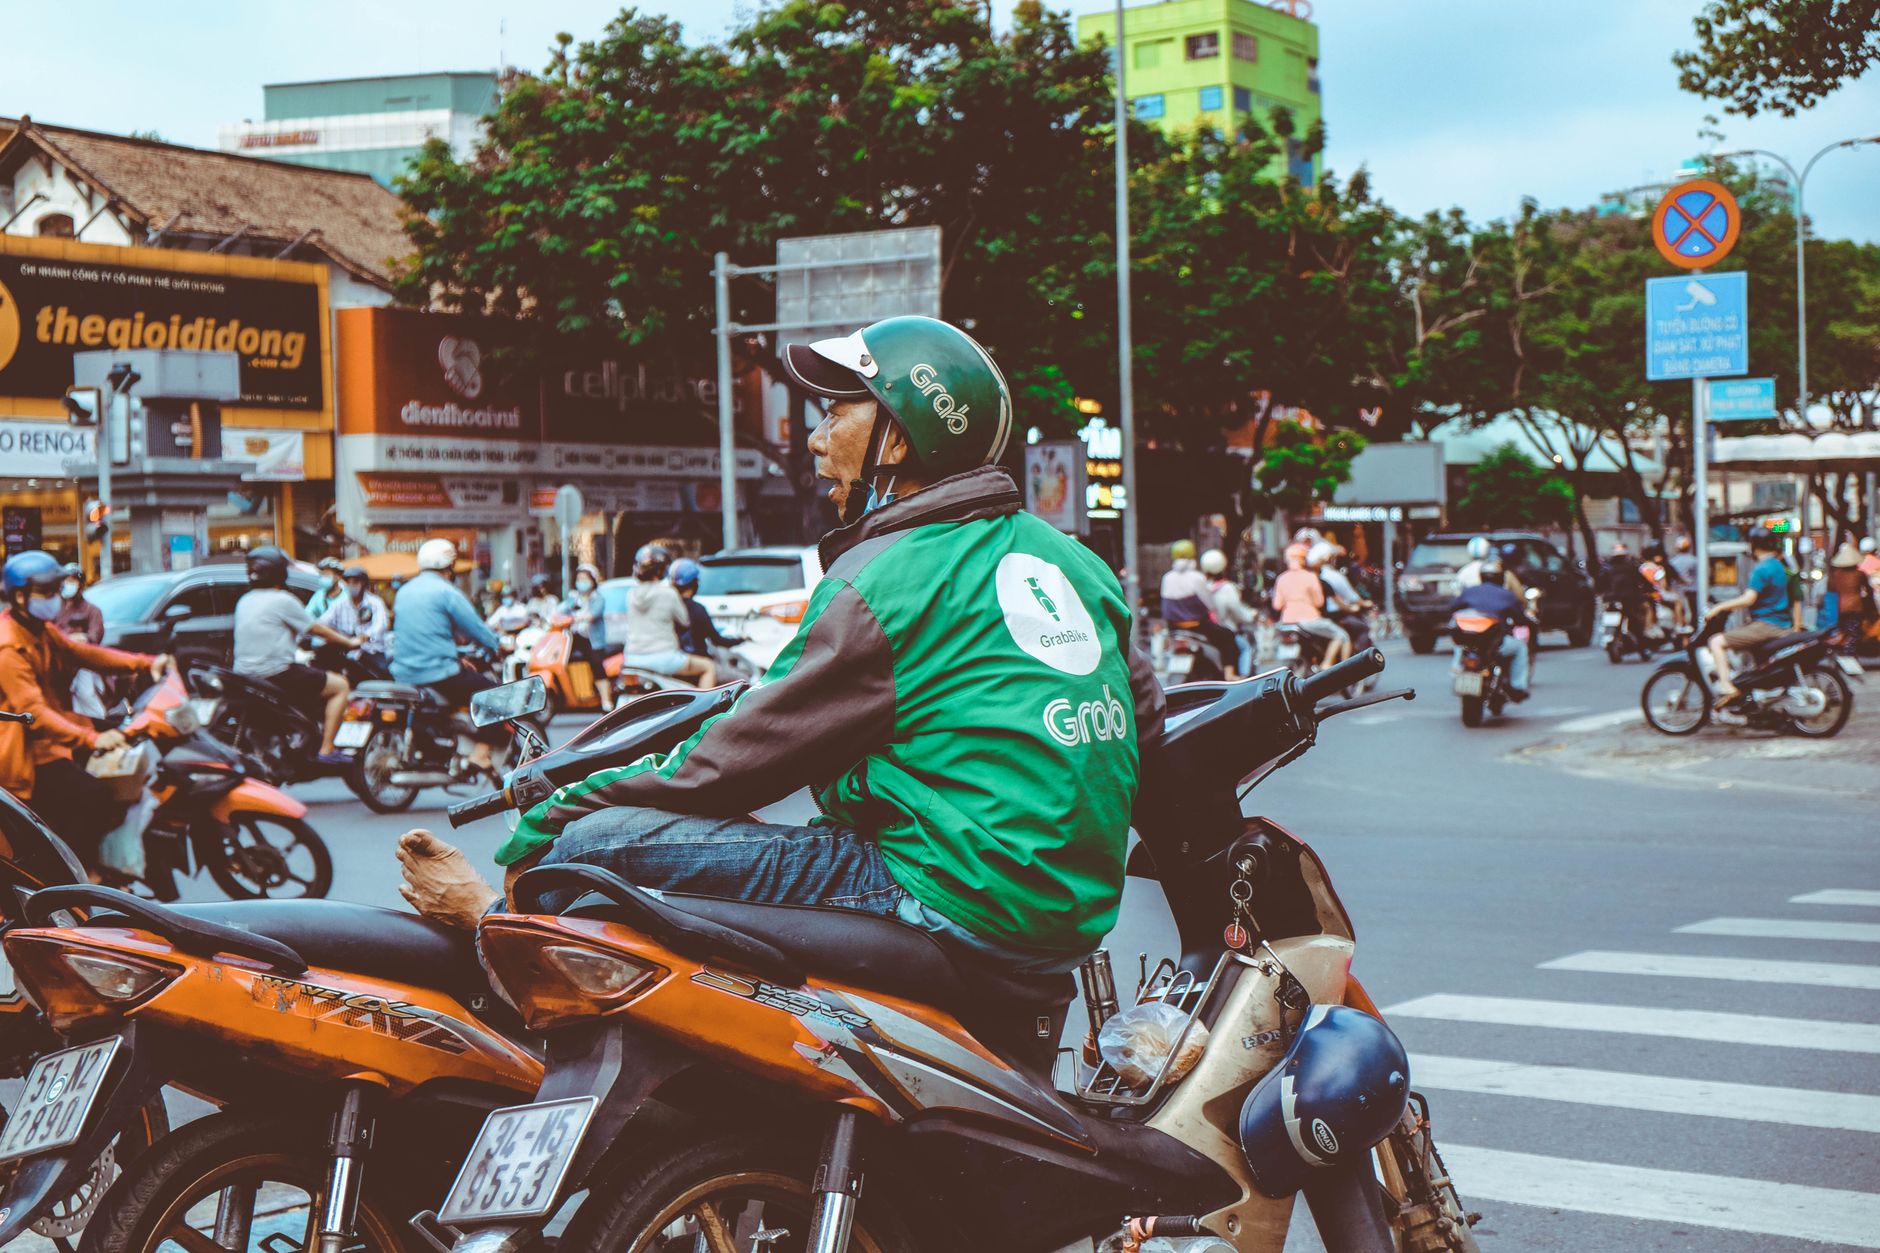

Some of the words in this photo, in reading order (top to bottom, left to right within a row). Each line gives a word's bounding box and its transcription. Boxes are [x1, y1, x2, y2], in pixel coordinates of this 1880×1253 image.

[36, 305, 306, 369] thegioididong
[401, 400, 520, 428] dienthoaivui
[910, 363, 970, 434] Grab
[20, 432, 87, 452] RENO4
[1040, 630, 1089, 648] GrabBike
[1043, 684, 1127, 747] Grab
[7, 1096, 80, 1152] 2890
[1317, 1124, 1336, 1151] TONATO
[460, 1160, 553, 1213] 9553
